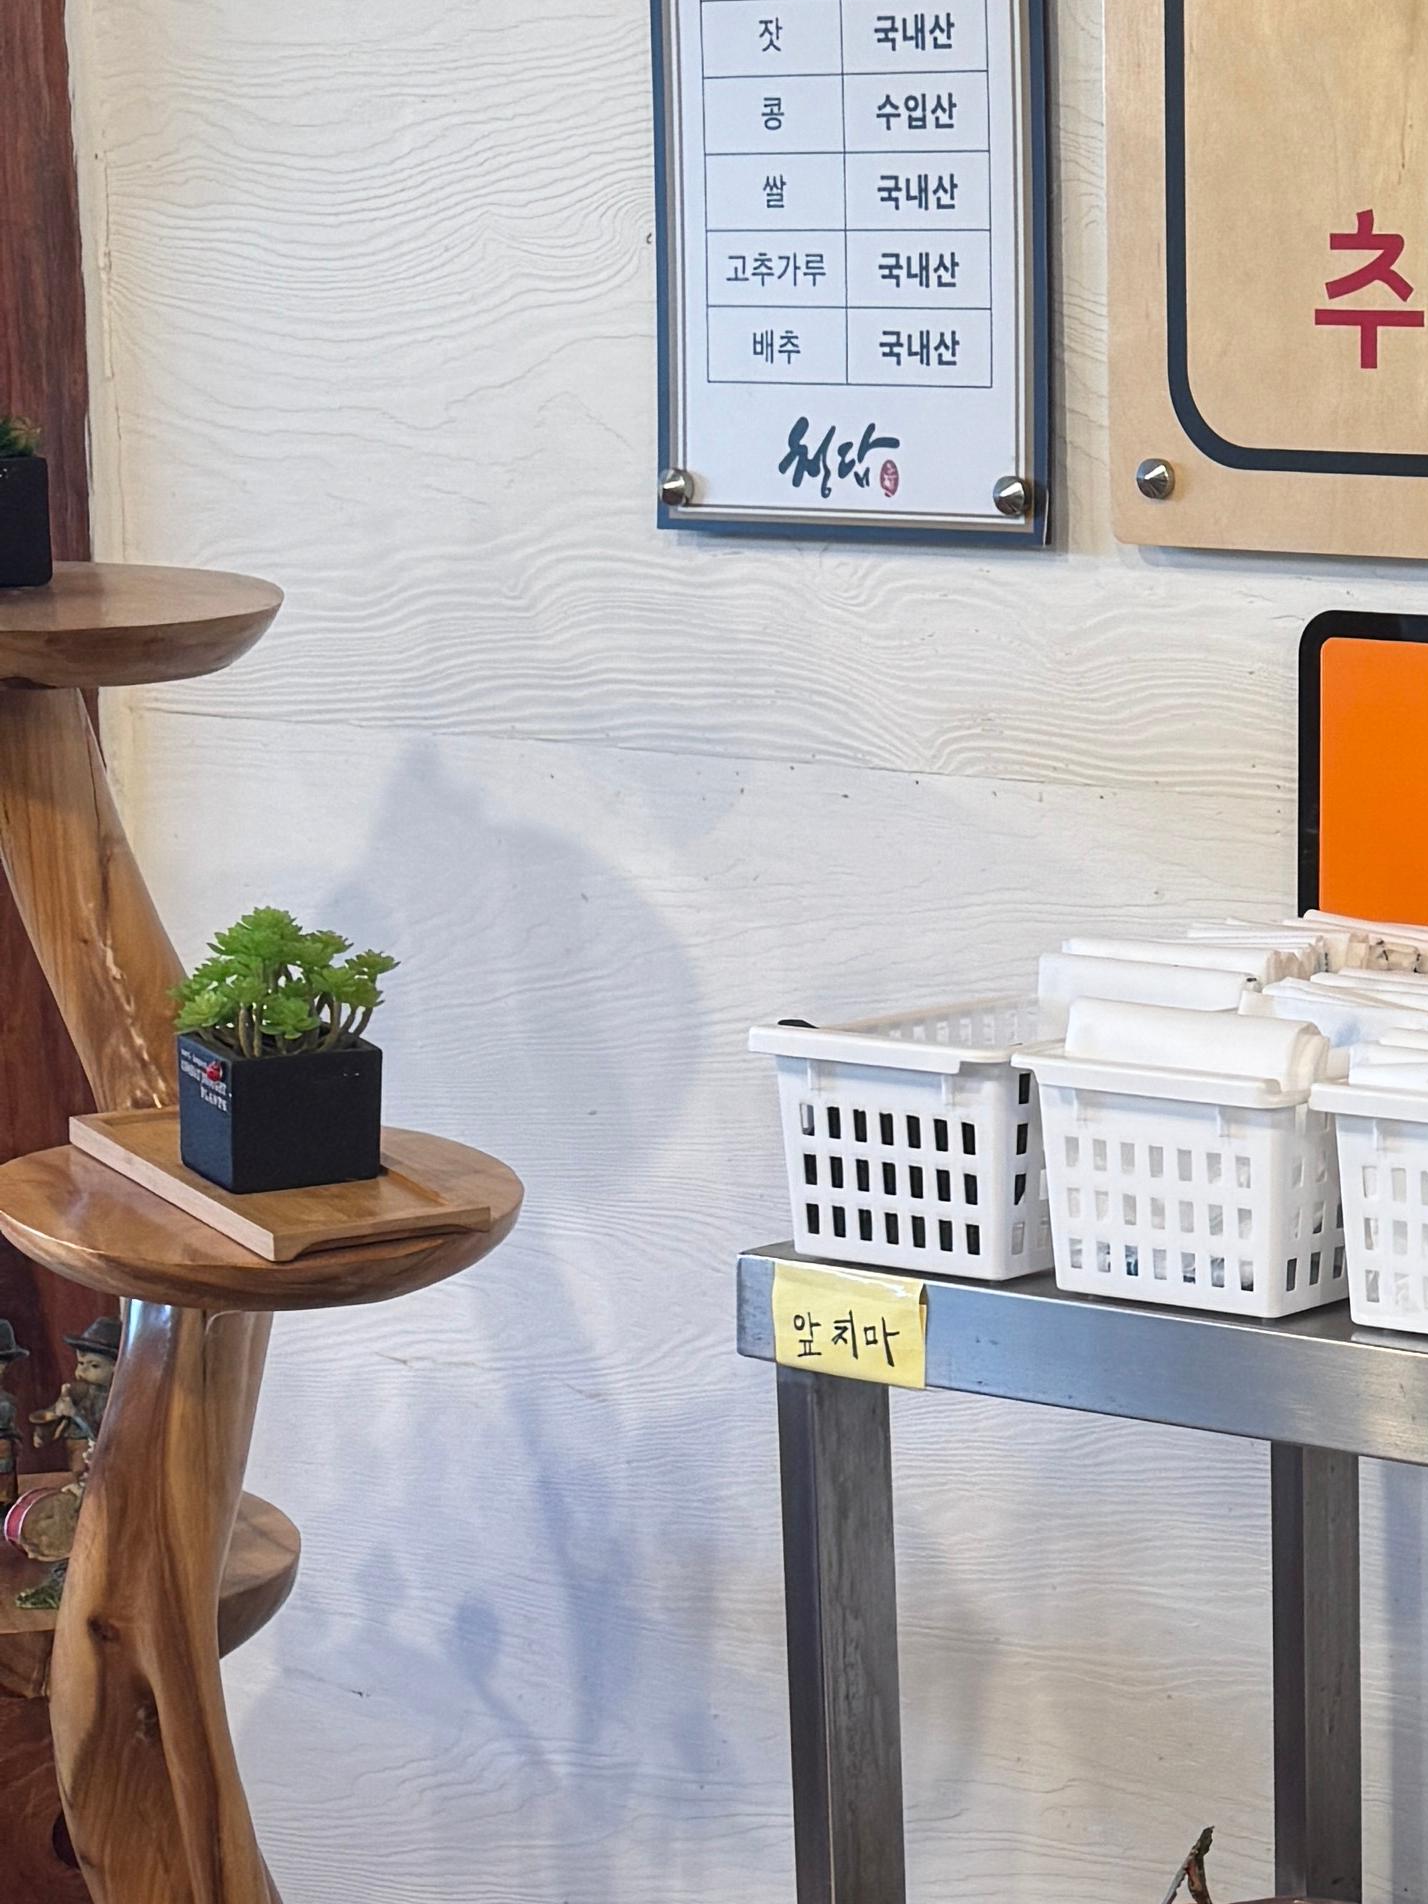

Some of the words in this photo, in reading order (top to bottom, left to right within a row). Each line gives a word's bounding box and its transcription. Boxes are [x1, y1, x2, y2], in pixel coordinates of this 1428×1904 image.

[759, 18, 782, 51] 잣
[874, 13, 954, 51] 국내산
[762, 98, 784, 130] 콩
[877, 93, 956, 130] 수입산
[764, 176, 786, 208] 쌀
[878, 174, 958, 210] 국내산
[727, 253, 825, 286] 고추가루
[879, 252, 959, 288] 국내산
[754, 330, 800, 364] 배추
[880, 330, 959, 366] 국내산
[793, 1309, 900, 1367] 앞치마
